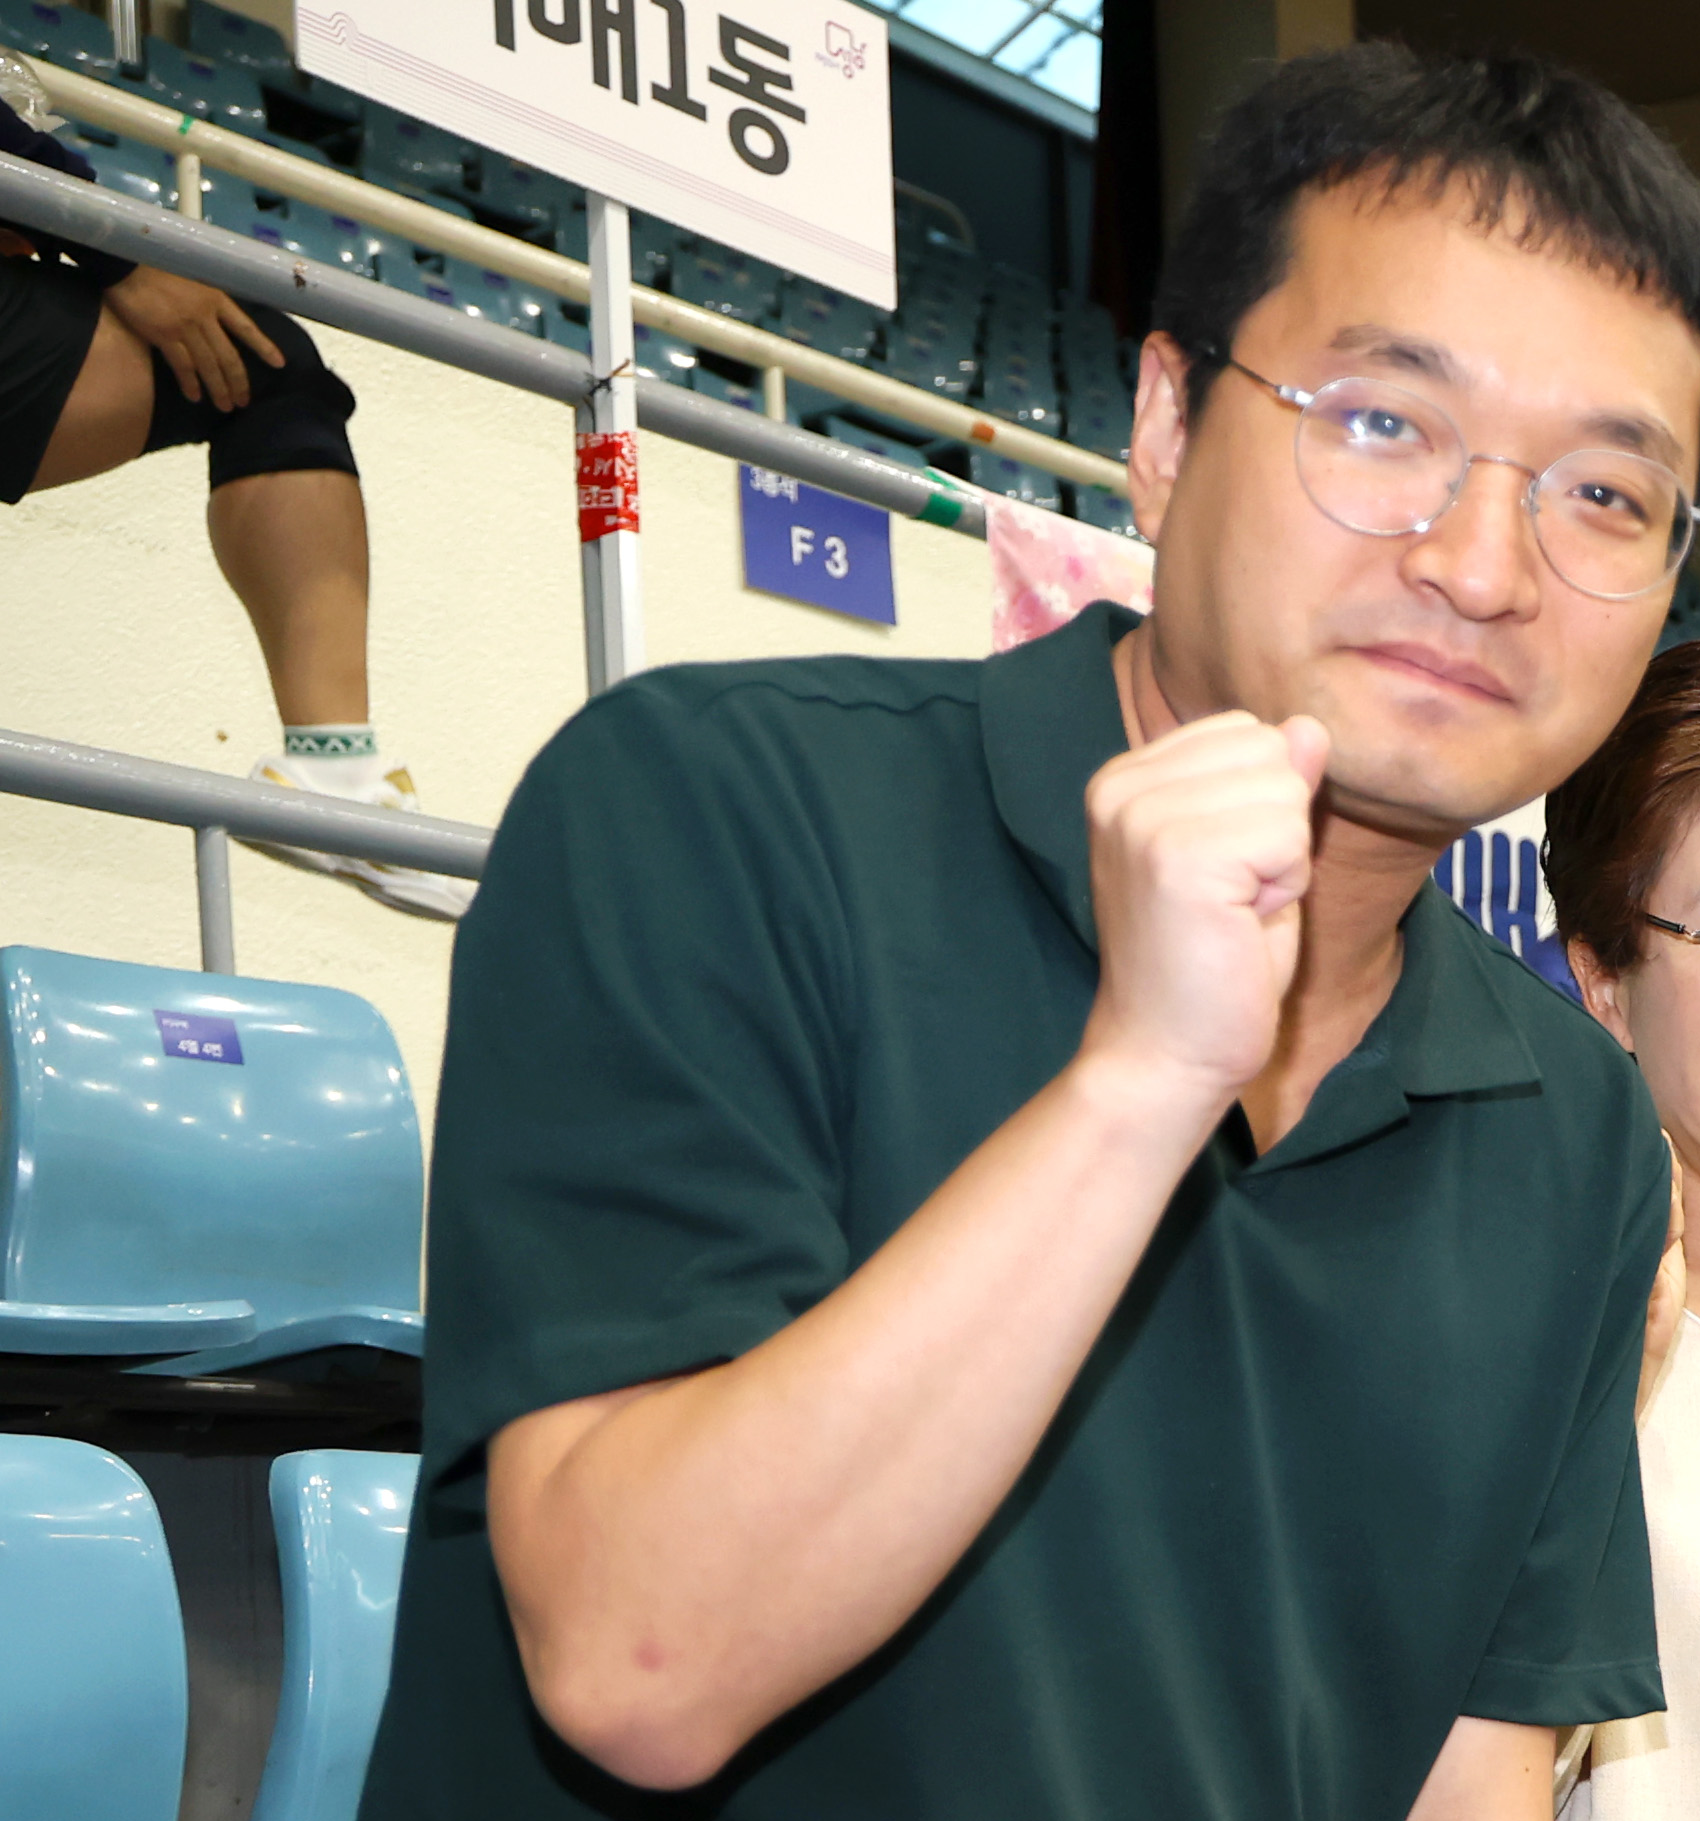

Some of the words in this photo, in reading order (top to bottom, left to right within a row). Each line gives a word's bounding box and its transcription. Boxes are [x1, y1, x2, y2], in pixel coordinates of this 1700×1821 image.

[495, 0, 807, 177] 매1동
[791, 525, 816, 567] F
[824, 536, 850, 580] 3
